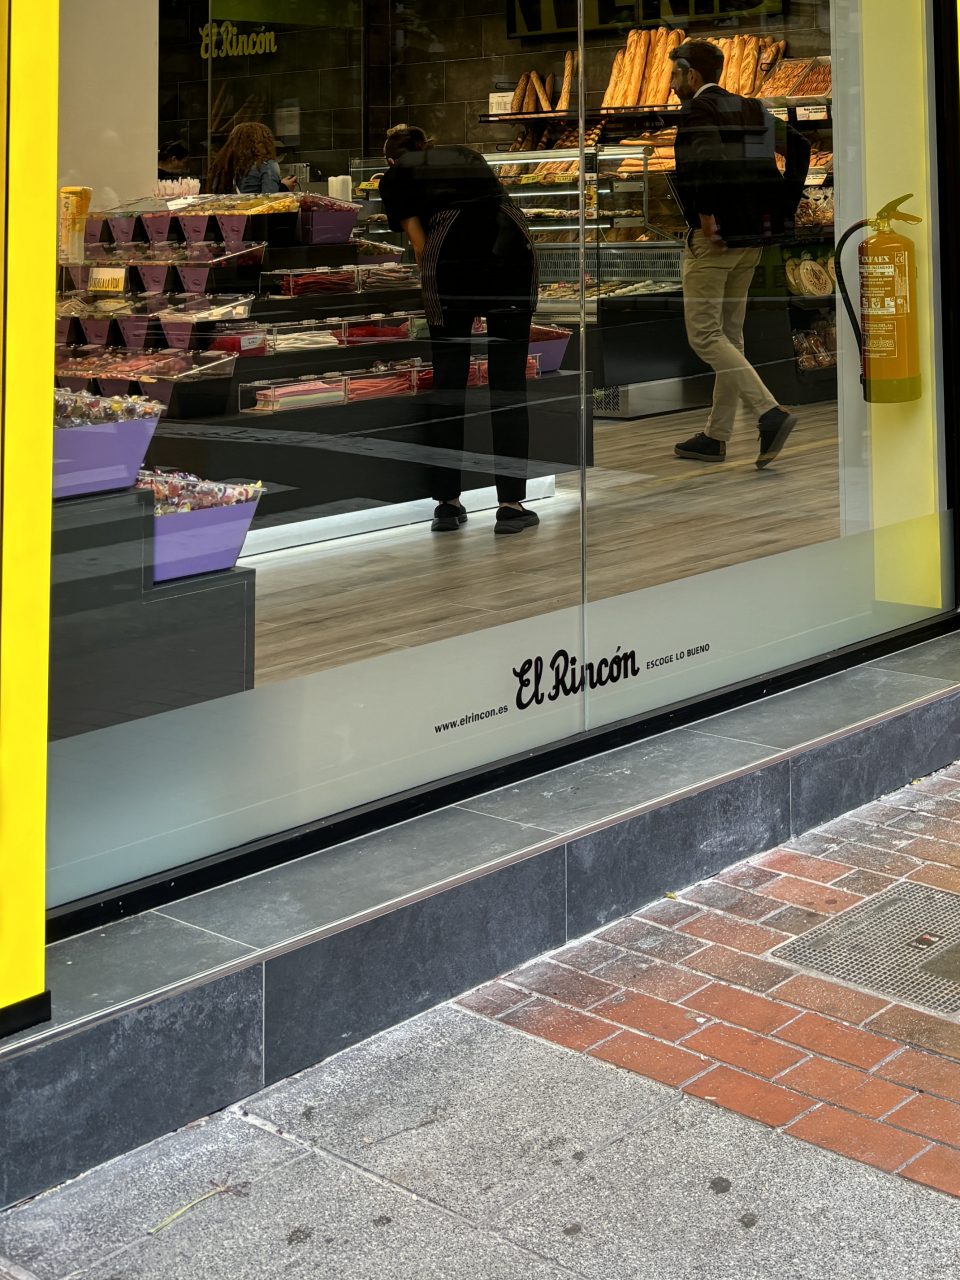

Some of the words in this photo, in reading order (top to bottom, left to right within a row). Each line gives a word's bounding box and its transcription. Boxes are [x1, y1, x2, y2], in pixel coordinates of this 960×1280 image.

[198, 22, 219, 59] El
[218, 21, 277, 57] Rincón
[646, 653, 674, 670] ESCOGE
[675, 651, 685, 662] LO
[686, 643, 710, 657] BUENO
[513, 655, 544, 710] El
[548, 646, 640, 701] Rincón
[434, 704, 508, 734] www.elrincon.es
